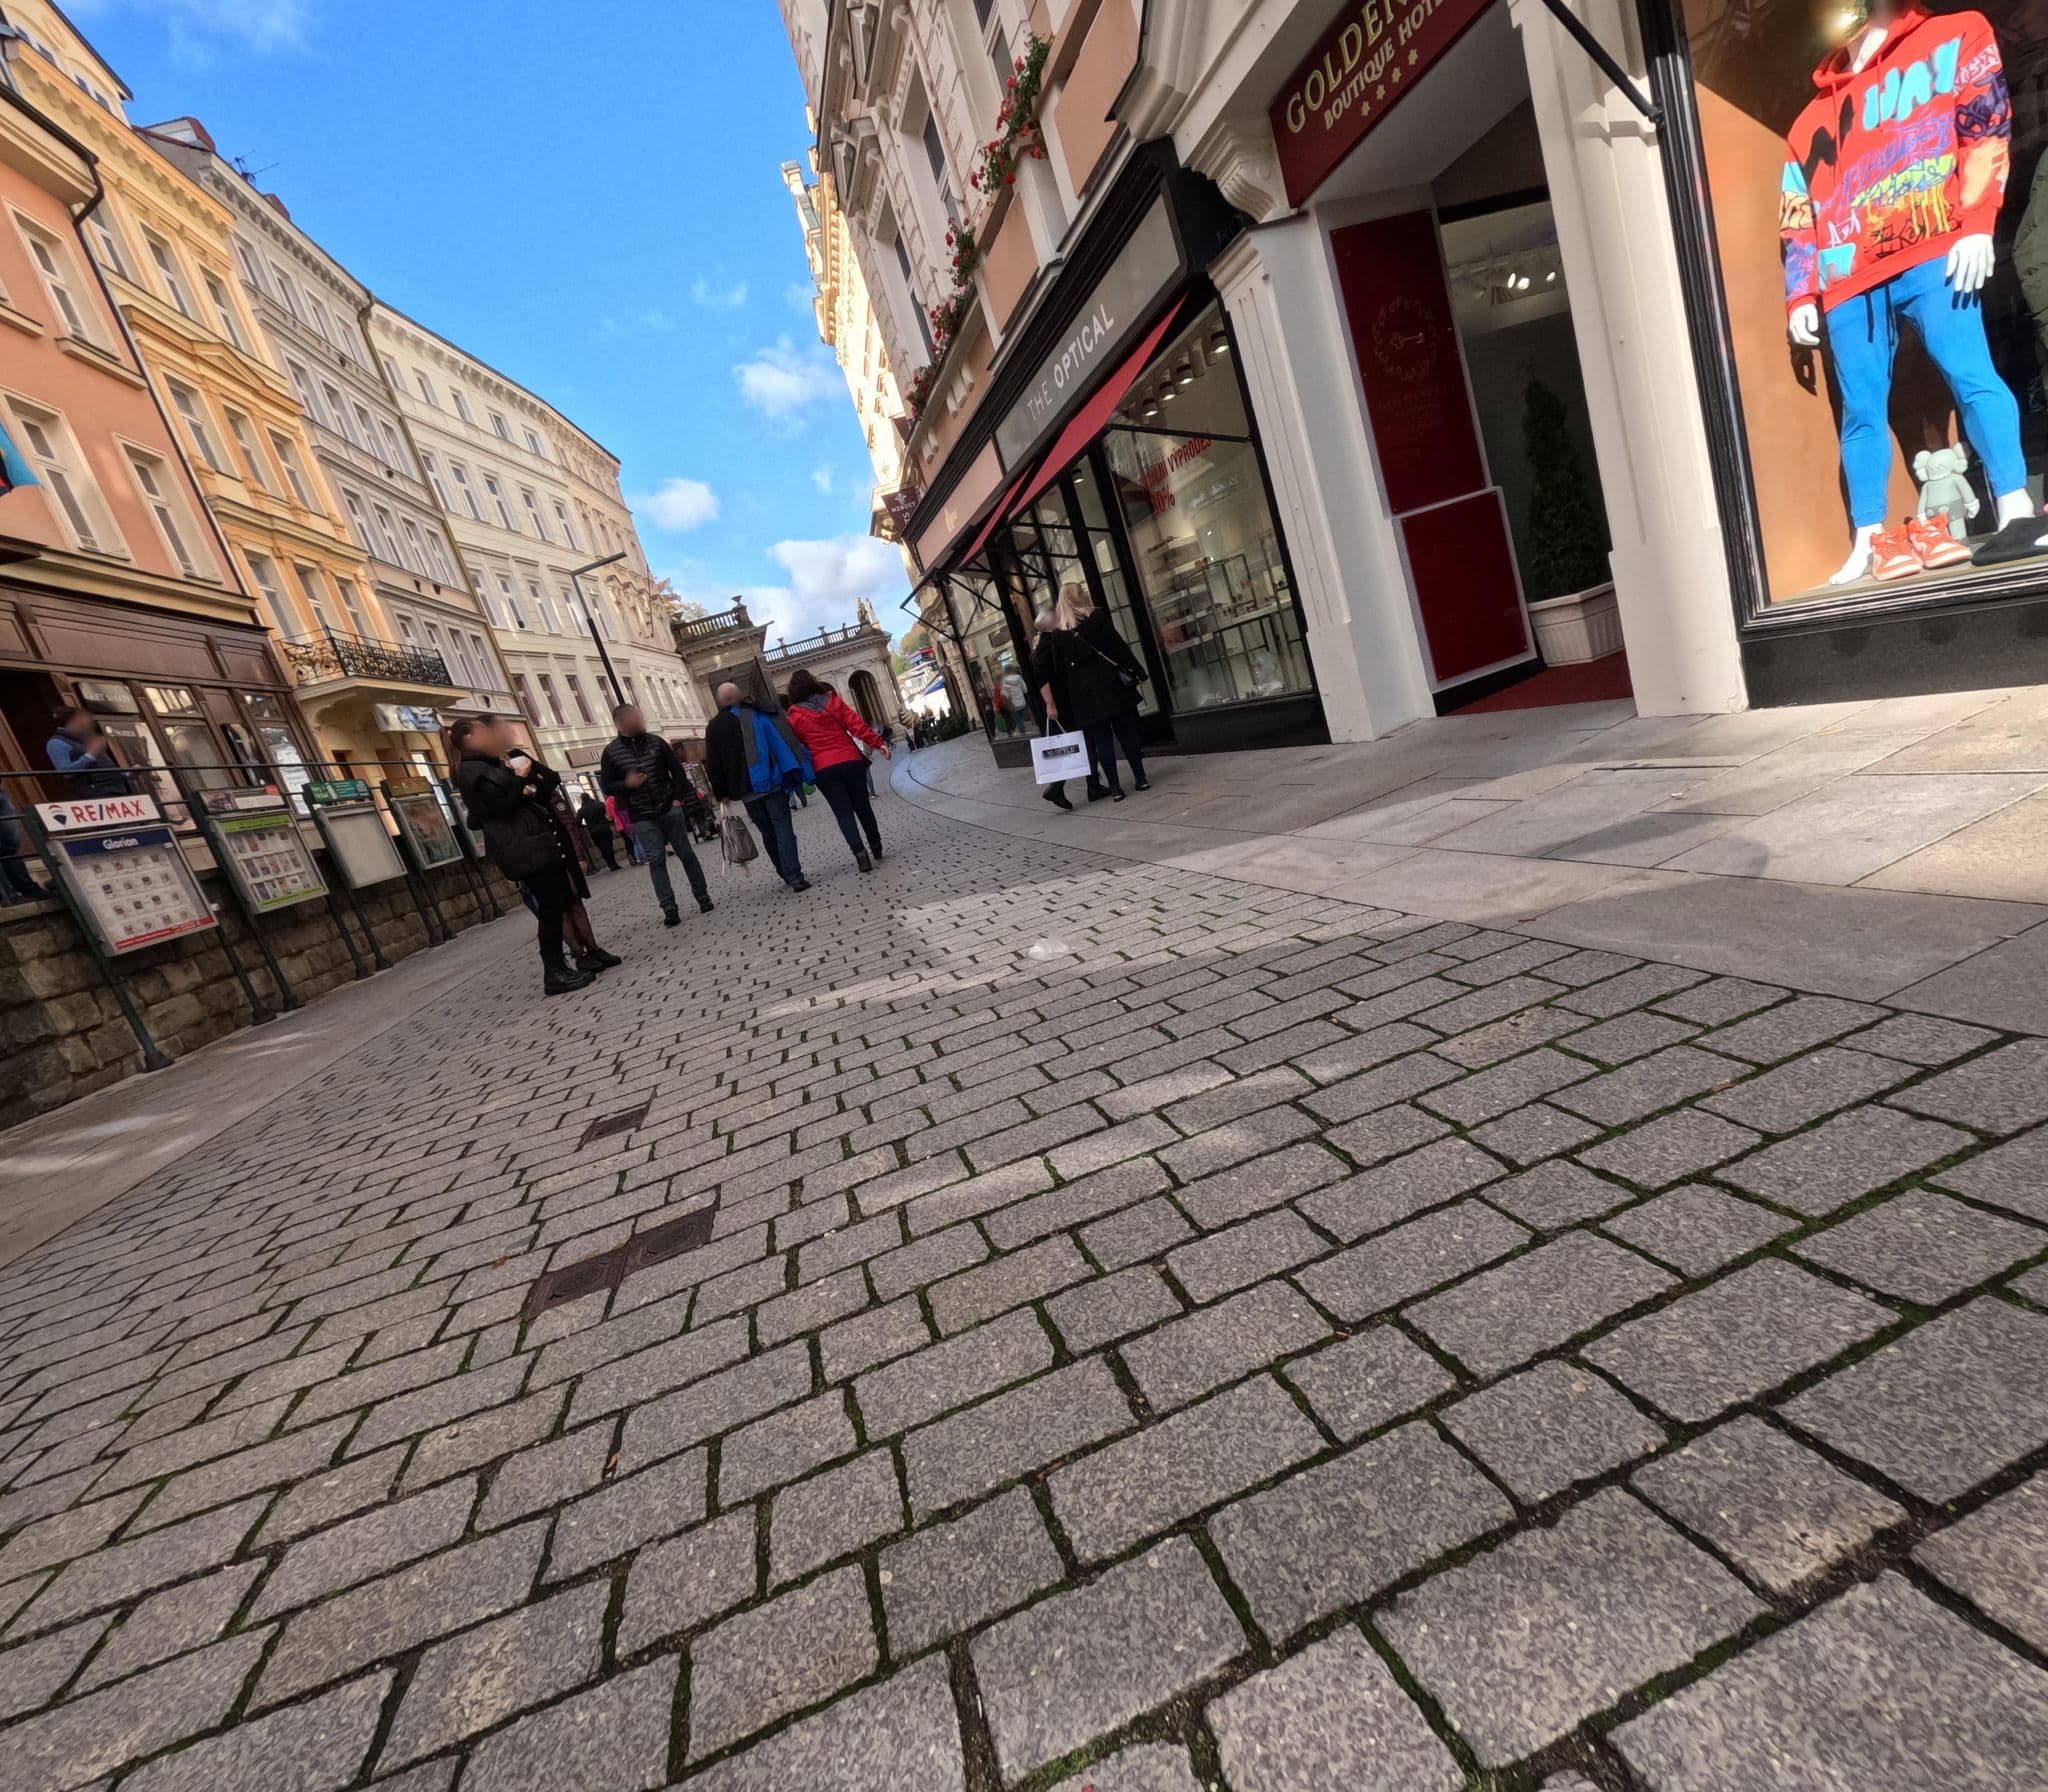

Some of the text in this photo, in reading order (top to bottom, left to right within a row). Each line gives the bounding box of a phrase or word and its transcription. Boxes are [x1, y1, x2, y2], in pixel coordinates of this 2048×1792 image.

[1323, 37, 1395, 131] BOUTIQUE
[1026, 303, 1115, 422] THE OPTICAL
[70, 799, 146, 823] RE/MAX
